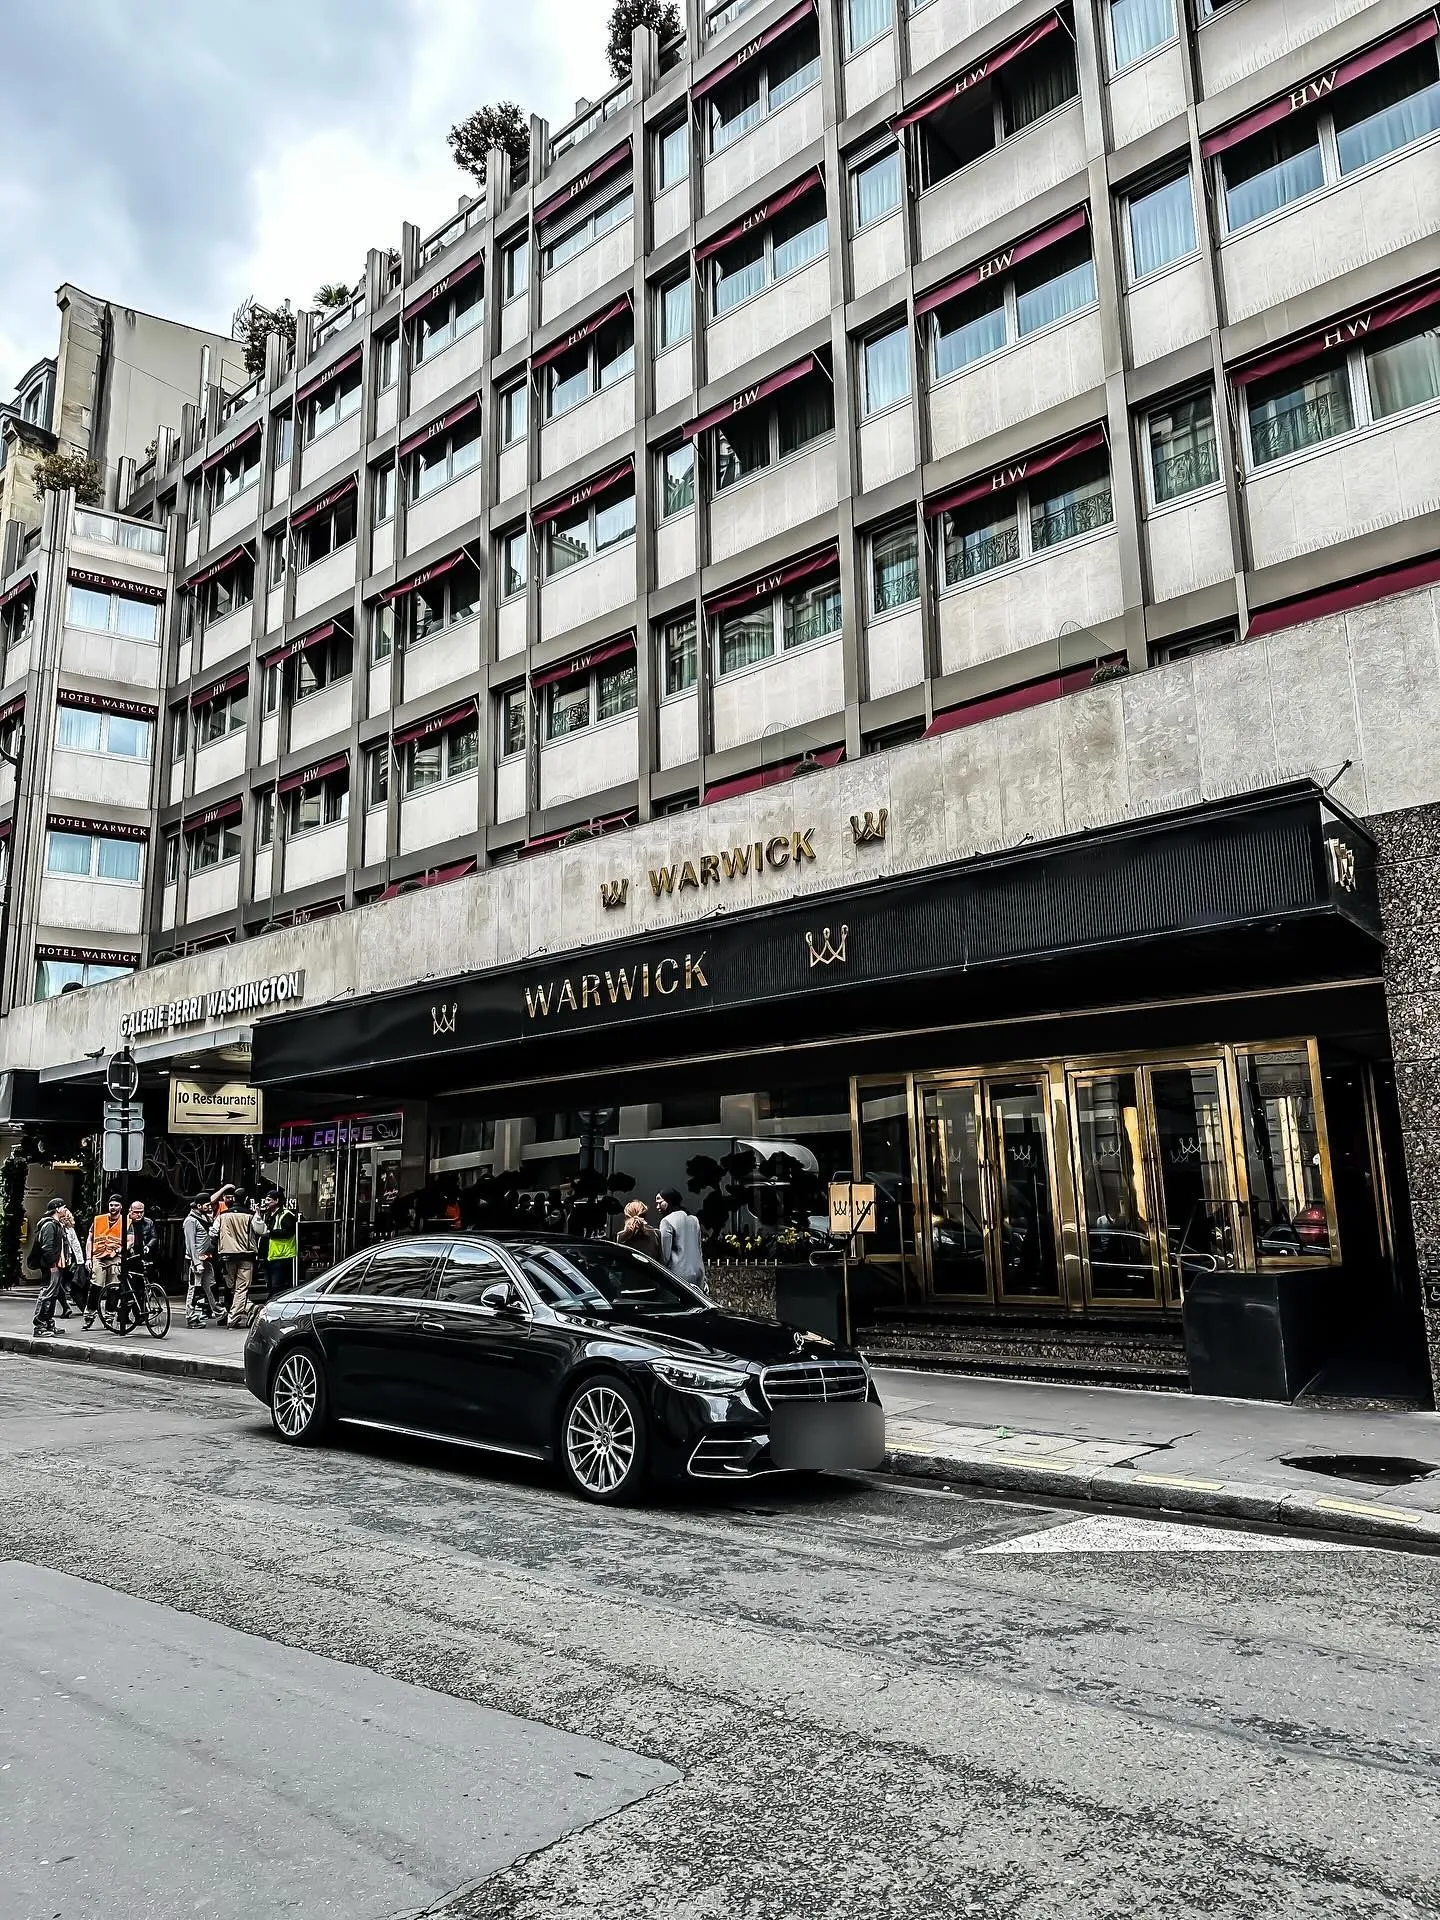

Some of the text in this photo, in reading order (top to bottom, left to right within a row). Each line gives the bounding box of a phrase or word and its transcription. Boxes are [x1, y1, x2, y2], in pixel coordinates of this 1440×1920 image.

[735, 36, 764, 65] HW
[954, 63, 988, 97] HW
[1288, 70, 1337, 113] HW
[570, 172, 592, 197] HW
[741, 205, 768, 232] HW
[978, 249, 1016, 282] HW
[431, 278, 450, 300] HW
[567, 325, 589, 346] HW
[1321, 313, 1372, 350] HW
[321, 366, 337, 384] HW
[731, 385, 761, 413] HW
[427, 417, 446, 437] HW
[991, 462, 1028, 490] HW
[571, 486, 593, 505] HW
[71, 569, 163, 598] HOTEL WARWICK
[413, 570, 432, 587] HW
[755, 574, 783, 596] HW
[291, 637, 307, 653] HW
[570, 656, 592, 673] HW
[213, 680, 227, 696] HW
[60, 691, 155, 715] HOTEL WARWICK
[424, 718, 444, 734] HW
[303, 767, 320, 783] HW
[50, 816, 147, 836] HOTEL WARWICK
[204, 809, 219, 823] HW
[648, 826, 818, 898] WARWICK
[38, 946, 137, 963] HOTEL WARWICK
[523, 950, 710, 1018] WARWICK
[120, 970, 302, 1038] GALERIE BERRI WASHINGTON
[178, 1092, 257, 1106] 10 Restaurants
